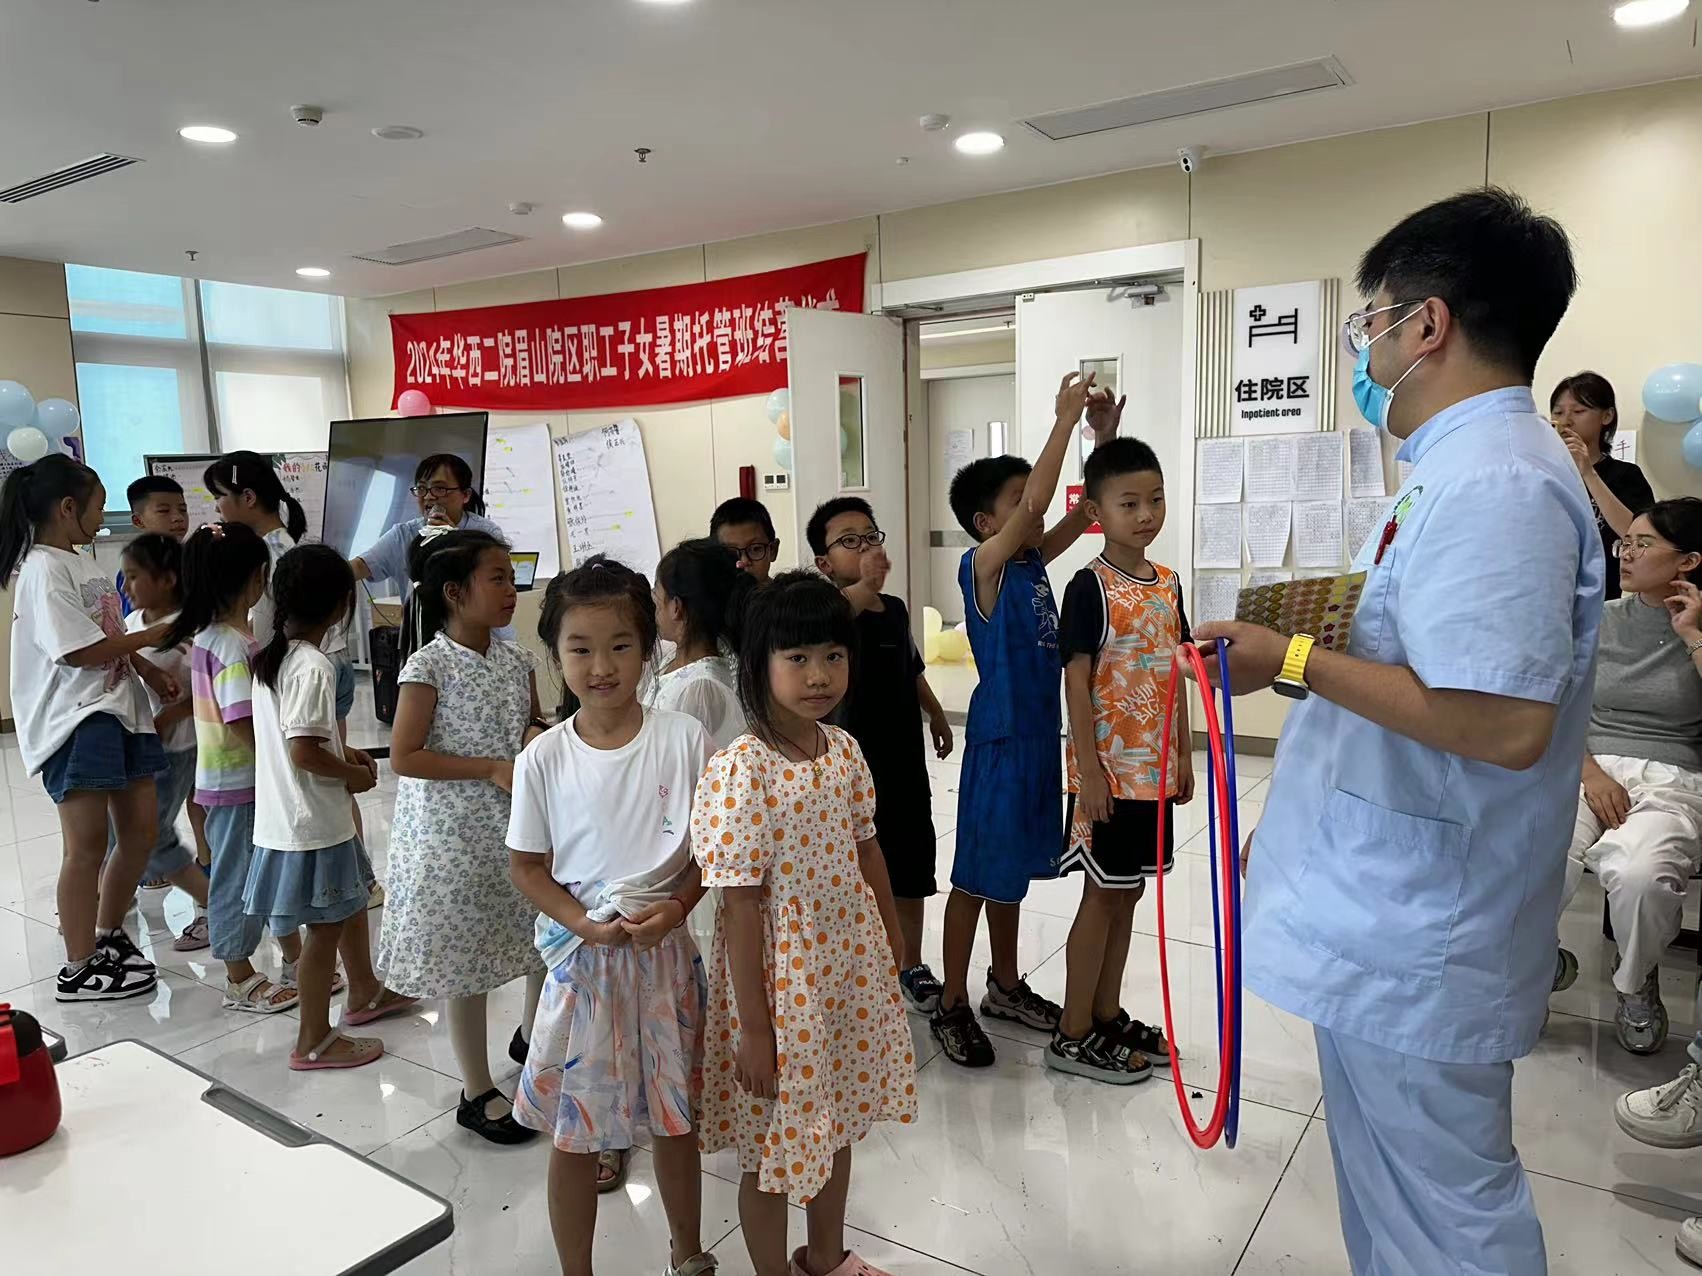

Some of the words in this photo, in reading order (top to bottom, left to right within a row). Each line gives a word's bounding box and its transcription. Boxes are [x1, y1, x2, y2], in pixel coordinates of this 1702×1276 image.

[406, 287, 840, 389] 2024年华西二院眉山院区职工子女暑期托管班结营
[1234, 375, 1310, 403] 住院区
[1241, 406, 1280, 421] Inpatient
[1281, 407, 1302, 418] area
